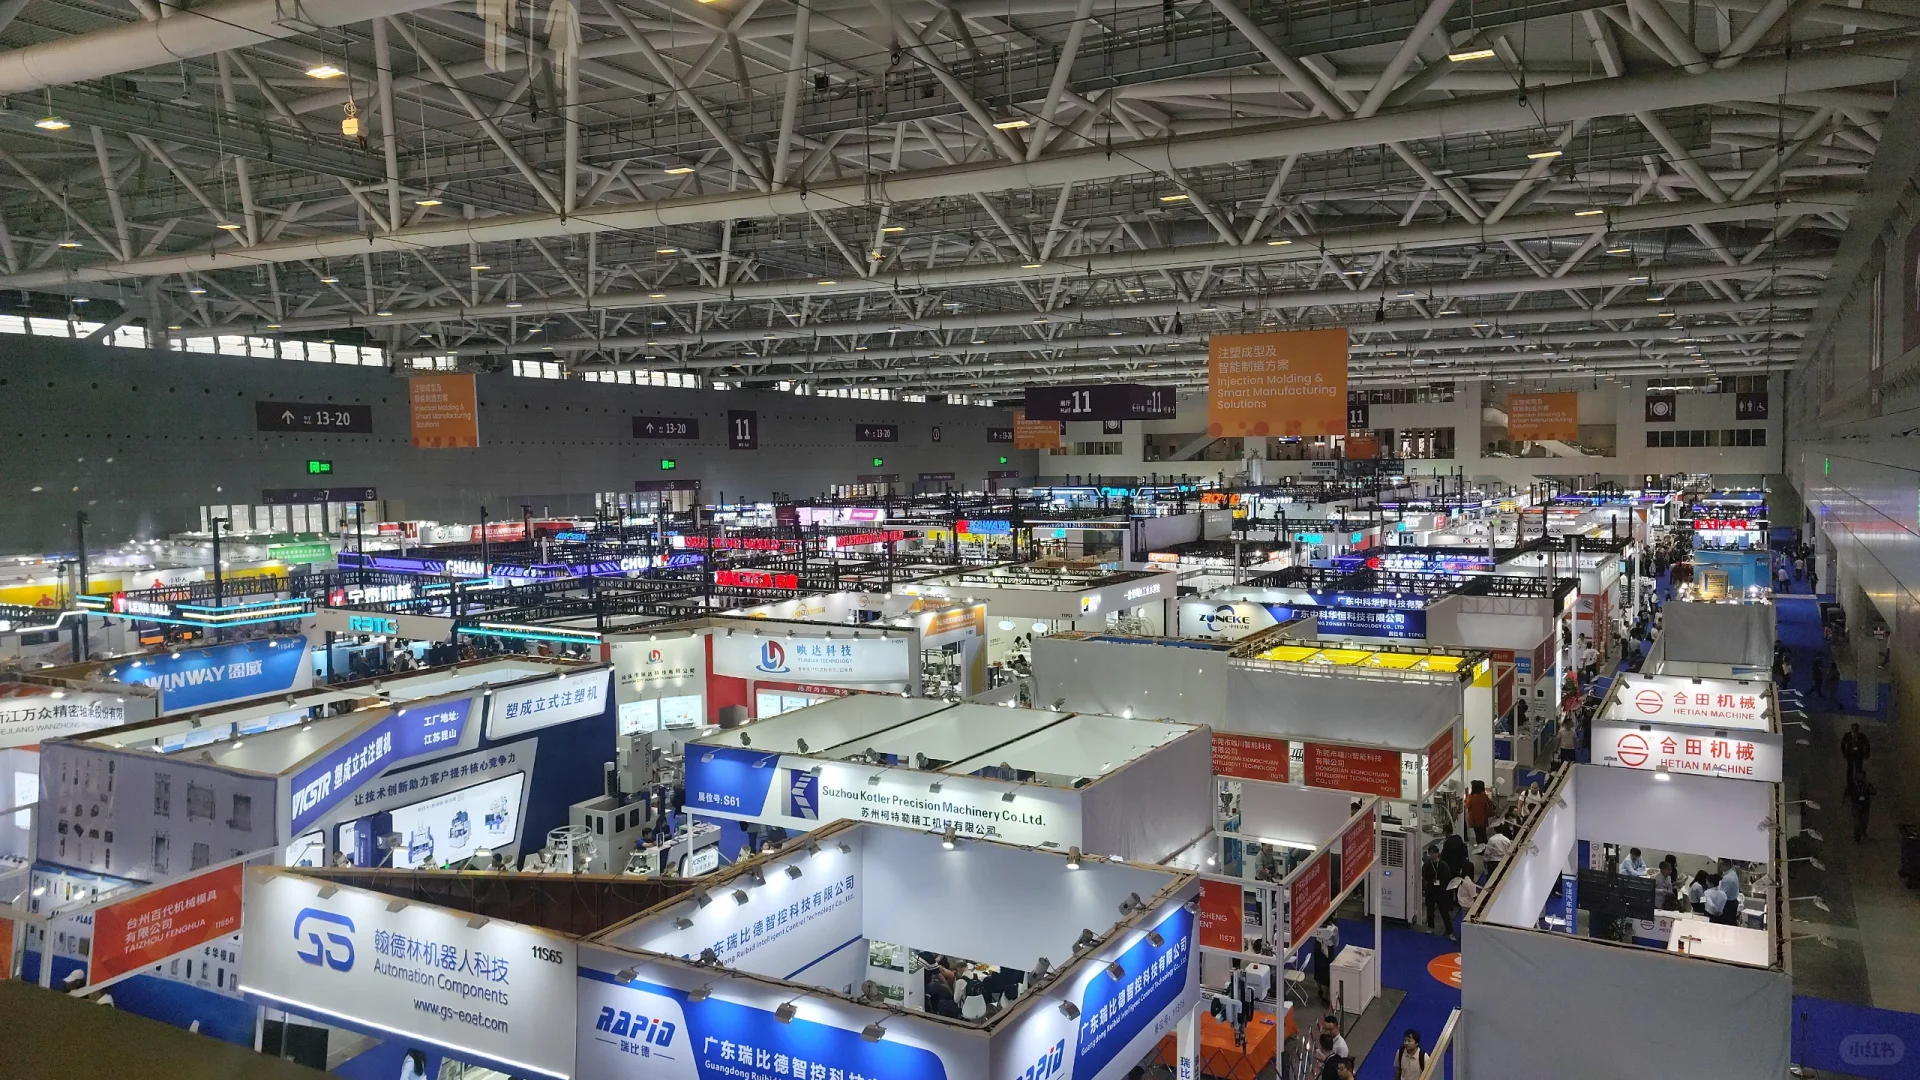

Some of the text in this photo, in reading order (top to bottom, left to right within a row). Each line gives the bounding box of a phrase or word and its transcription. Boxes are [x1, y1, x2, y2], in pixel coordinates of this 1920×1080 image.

[1218, 345, 1277, 359] 注塑成型及
[1217, 359, 1289, 373] 智能制造方案
[1217, 373, 1323, 388] Injection Molding &
[1217, 385, 1337, 397] Smart Manufacturing
[1072, 391, 1092, 413] 11
[1152, 391, 1162, 412] 11
[1217, 399, 1267, 409] Solutions
[316, 411, 350, 426] 13-20
[1350, 409, 1364, 424] 11
[666, 423, 686, 434] 13-20
[735, 418, 751, 440] 11
[323, 490, 330, 501] 7
[1199, 614, 1250, 625] ZONEKE
[796, 644, 852, 657] 映达科技
[142, 660, 263, 690] WINWAY 盈威
[505, 684, 598, 720] 塑成立式注塑机
[1673, 691, 1756, 710] 合田机械
[1673, 708, 1755, 720] HETIAN MACHINE
[423, 729, 458, 746] 江苏昆山
[1212, 747, 1238, 756] 有限公司
[1660, 736, 1755, 761] 合田机械
[333, 731, 392, 791] 塑成立式注塑机
[1242, 763, 1278, 772] TECHNOLOGY
[1315, 758, 1345, 767] 有限公司
[1315, 765, 1349, 774] DONGGUAN
[1661, 759, 1753, 775] HETIAN MACHINE
[354, 752, 516, 807] 让技术创新助力客户提升核心竞争力
[1315, 772, 1389, 784] INTELLIGENT TECHNOLOGY
[822, 786, 859, 800] Suzhou
[860, 790, 891, 804] Kotler
[892, 795, 941, 811] Precision
[942, 801, 1000, 822] Machinery
[861, 807, 996, 835] 苏州柯特勒精工机械有限公司
[126, 889, 217, 931] 台州百代机械模具
[1200, 912, 1228, 922] SHENG
[125, 918, 173, 944] 有限公司
[215, 916, 235, 929] 11S55
[756, 928, 785, 949] Intelligent
[806, 904, 835, 922] Technology
[123, 918, 206, 955] TAIZHOU FENGHUA
[1219, 934, 1236, 943] 11S71
[374, 928, 510, 986] 翰德林机器人科技
[531, 945, 563, 965] 11S65
[373, 959, 508, 1006] Automation Components
[1080, 935, 1187, 1044] 广东瑞比德智控科技有限公司
[413, 998, 508, 1035] www.gs-eoat.com
[620, 1039, 650, 1058] 瑞比德
[704, 1036, 879, 1080] 广东瑞比德智控科技
[704, 1060, 750, 1080] Guangdong
